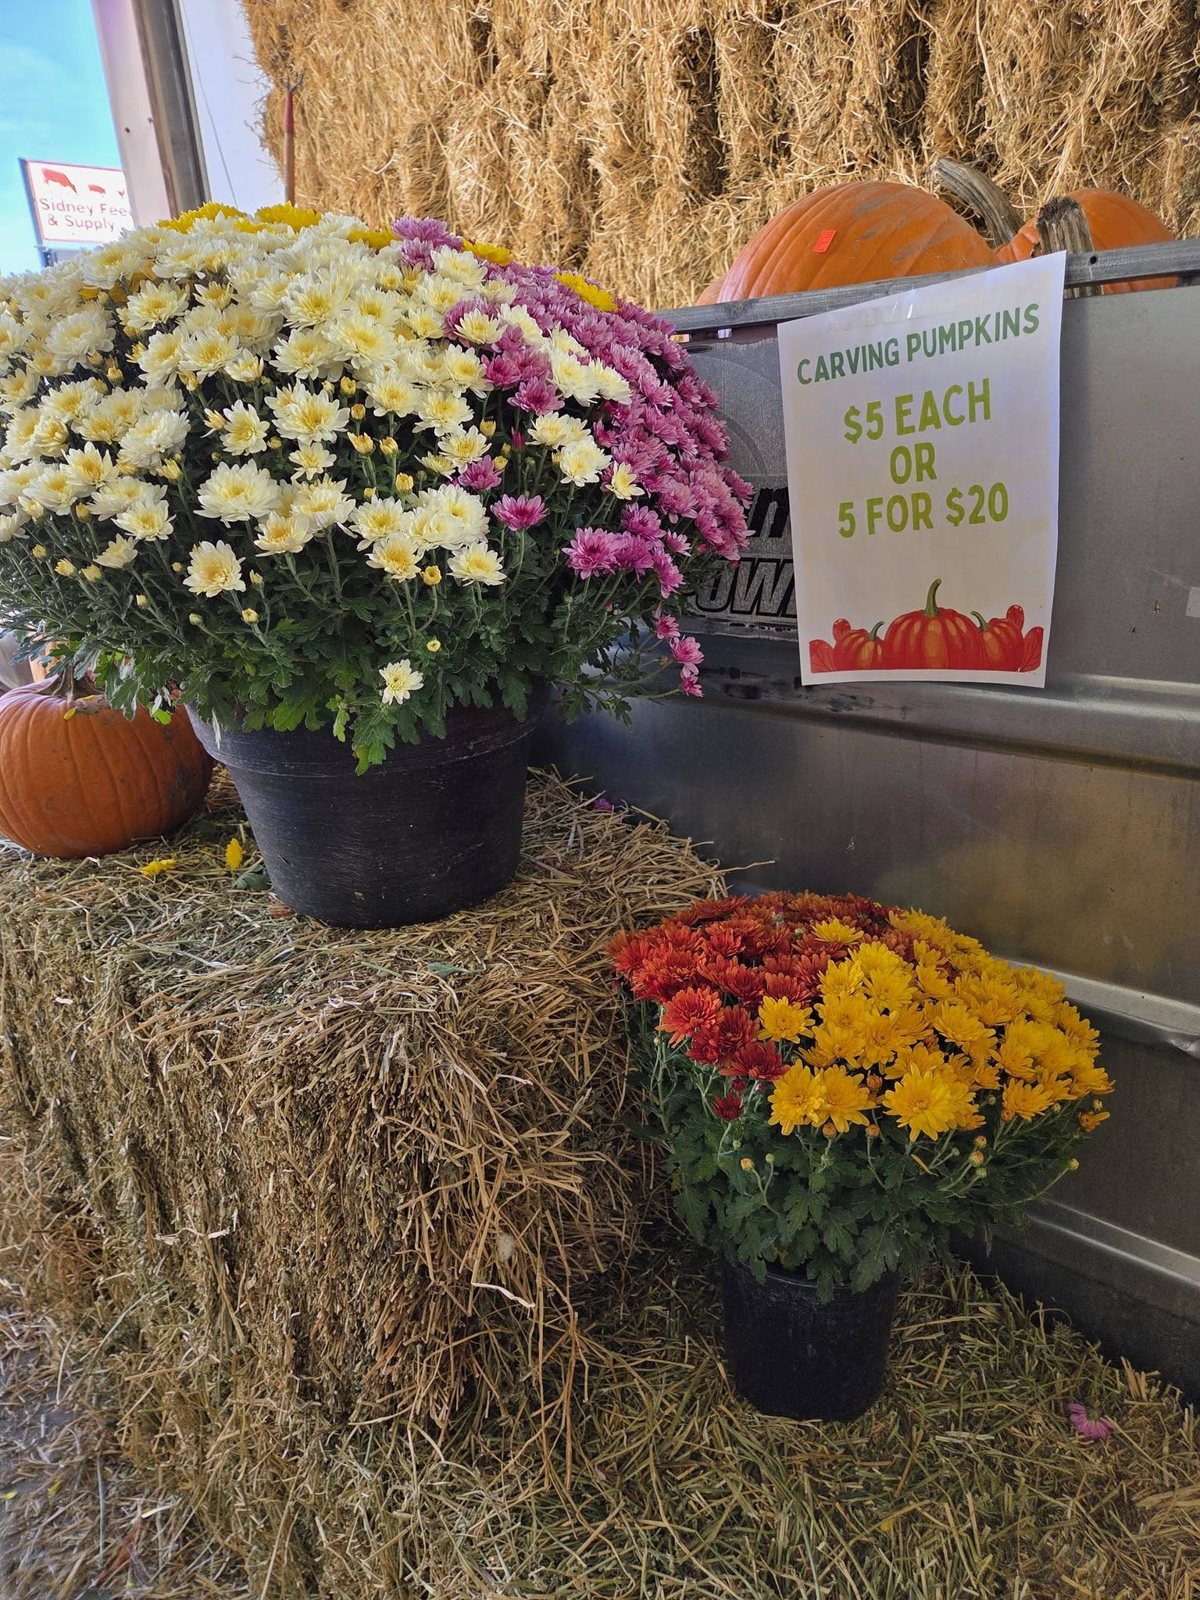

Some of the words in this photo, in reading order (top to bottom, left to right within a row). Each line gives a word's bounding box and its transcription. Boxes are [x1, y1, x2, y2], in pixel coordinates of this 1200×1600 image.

[39, 198, 94, 215] Sidney
[99, 203, 133, 217] Fee
[47, 214, 58, 226] &
[65, 215, 114, 231] Supply
[797, 338, 900, 385] CARVING
[906, 303, 1040, 362] PUMPKINS
[843, 400, 884, 444] $5
[894, 377, 991, 436] EACH
[889, 441, 937, 485] OR
[838, 501, 856, 538] 5
[866, 491, 934, 535] FOR
[945, 482, 1009, 527] $20
